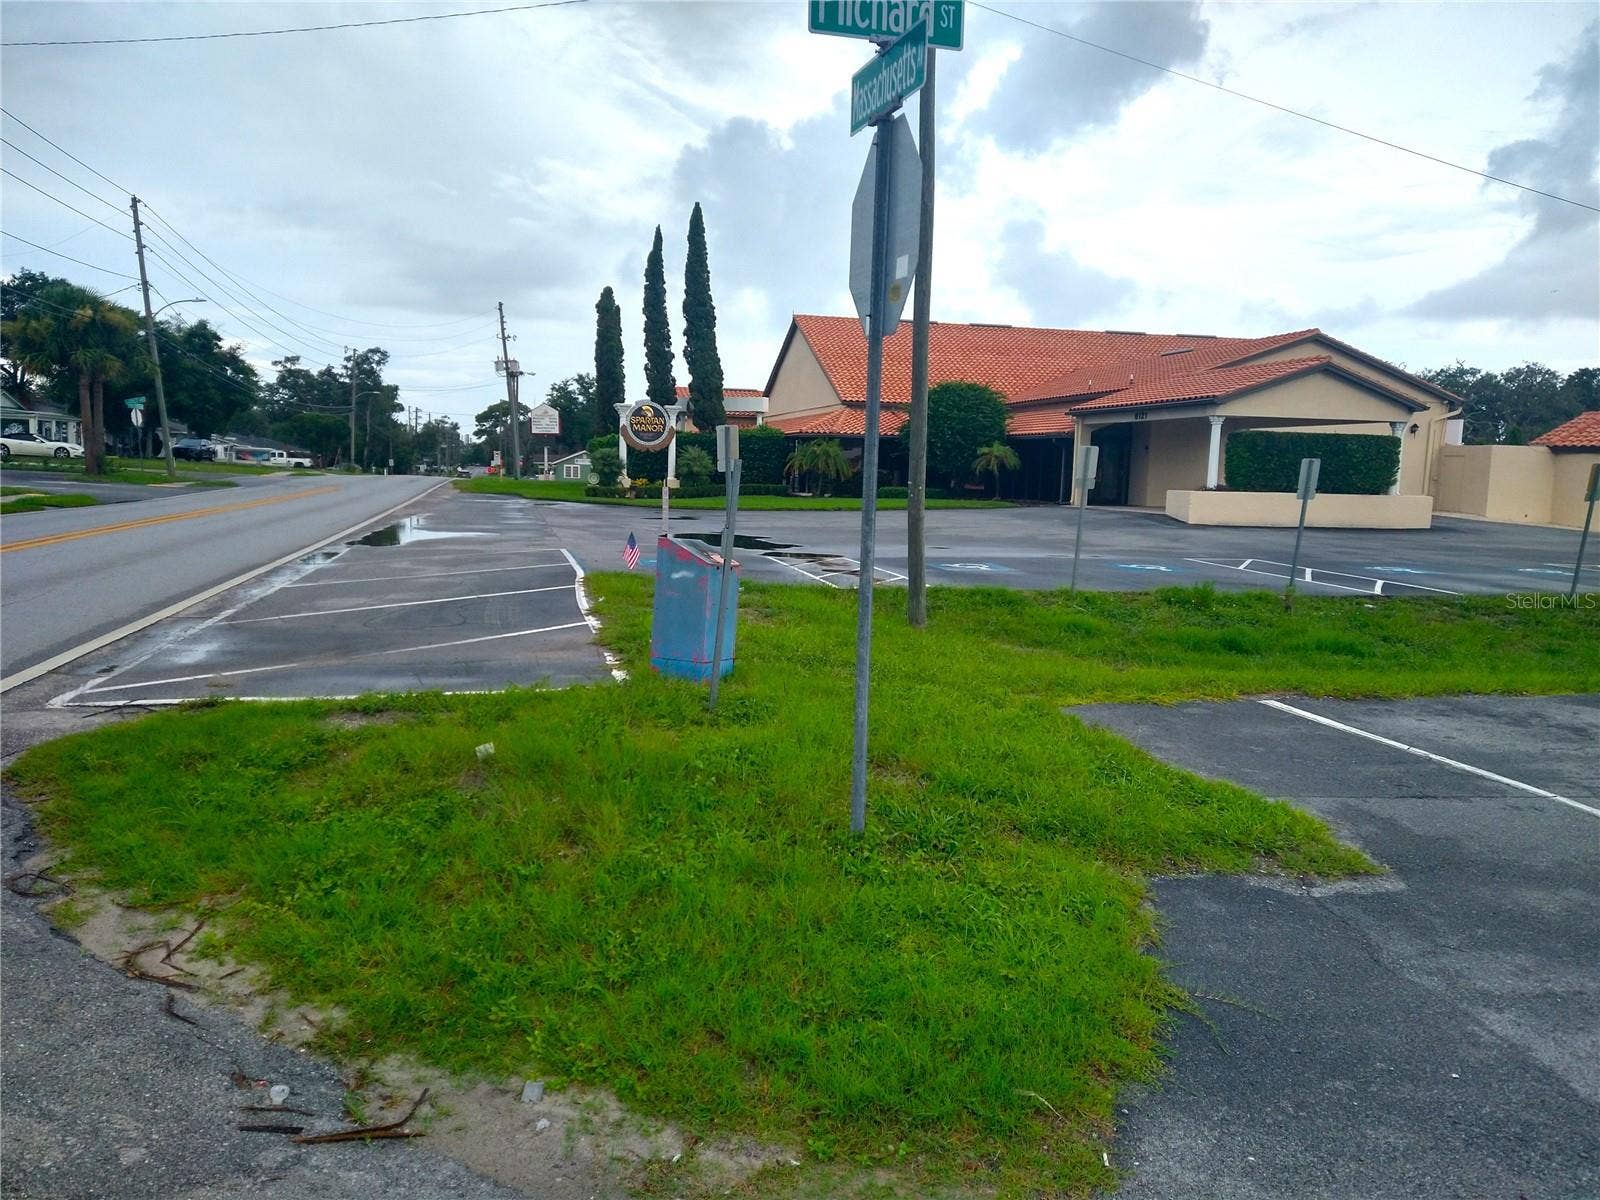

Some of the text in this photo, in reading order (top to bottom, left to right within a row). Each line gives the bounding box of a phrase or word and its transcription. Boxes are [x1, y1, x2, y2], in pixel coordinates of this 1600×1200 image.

[940, 4, 956, 28] ST
[853, 40, 916, 122] Massachusetts
[630, 416, 665, 425] SPARTAN
[632, 424, 664, 432] MANOR
